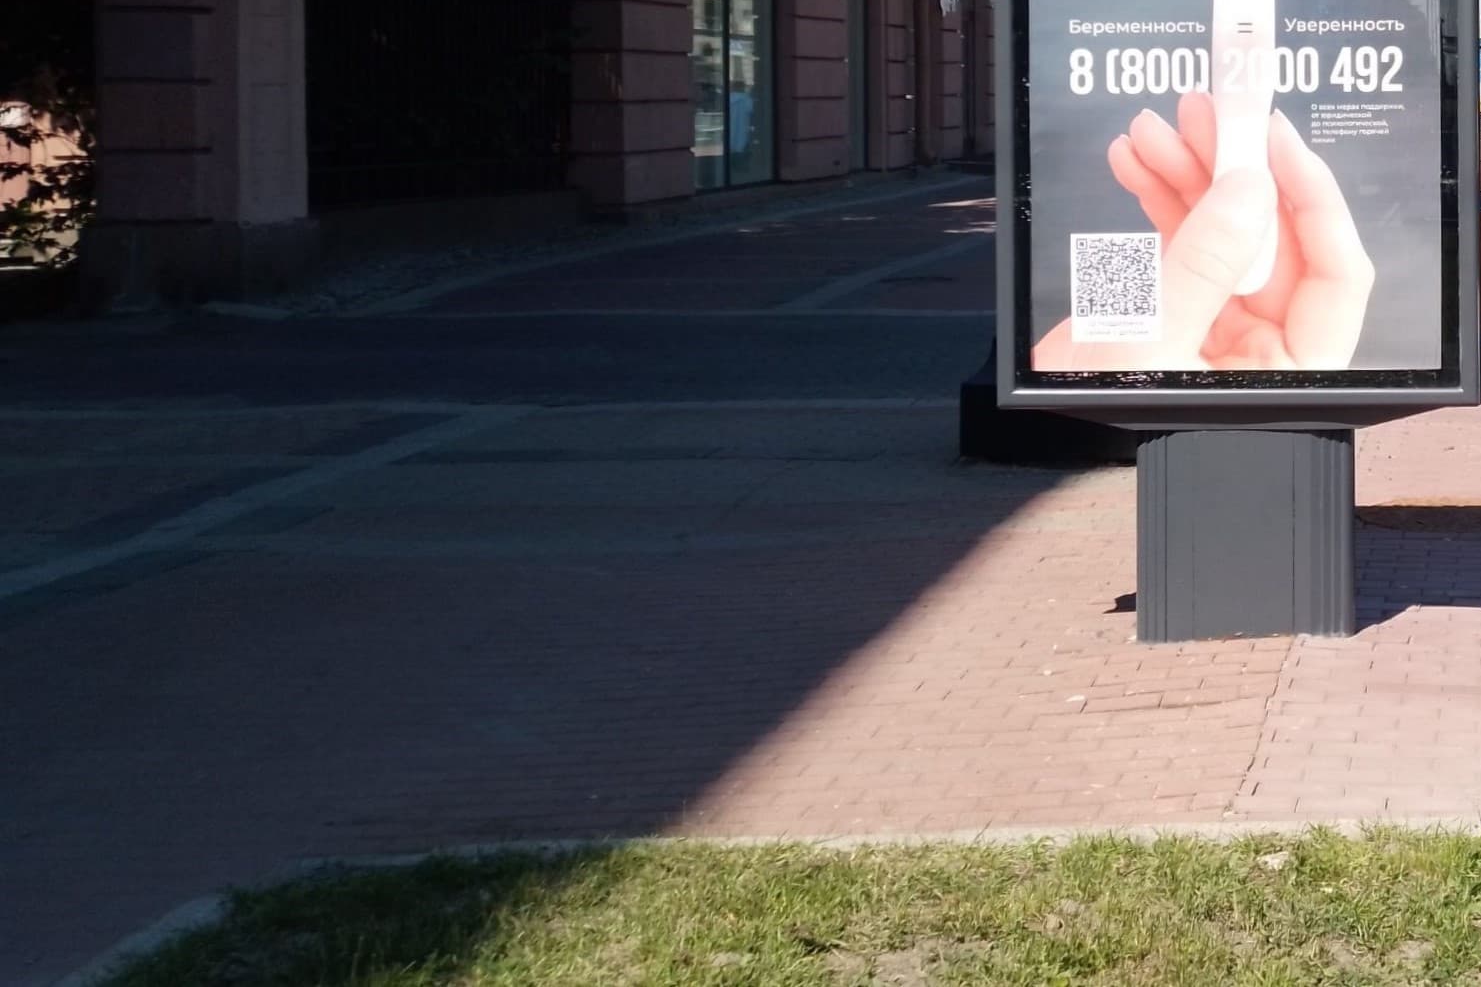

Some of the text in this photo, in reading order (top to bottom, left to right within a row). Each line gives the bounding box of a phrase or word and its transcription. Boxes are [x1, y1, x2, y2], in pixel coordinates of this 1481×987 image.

[1069, 19, 1206, 37] Беременность
[1284, 18, 1405, 35] Уверенность
[1070, 46, 1403, 95] 8 (800) 2000 492
